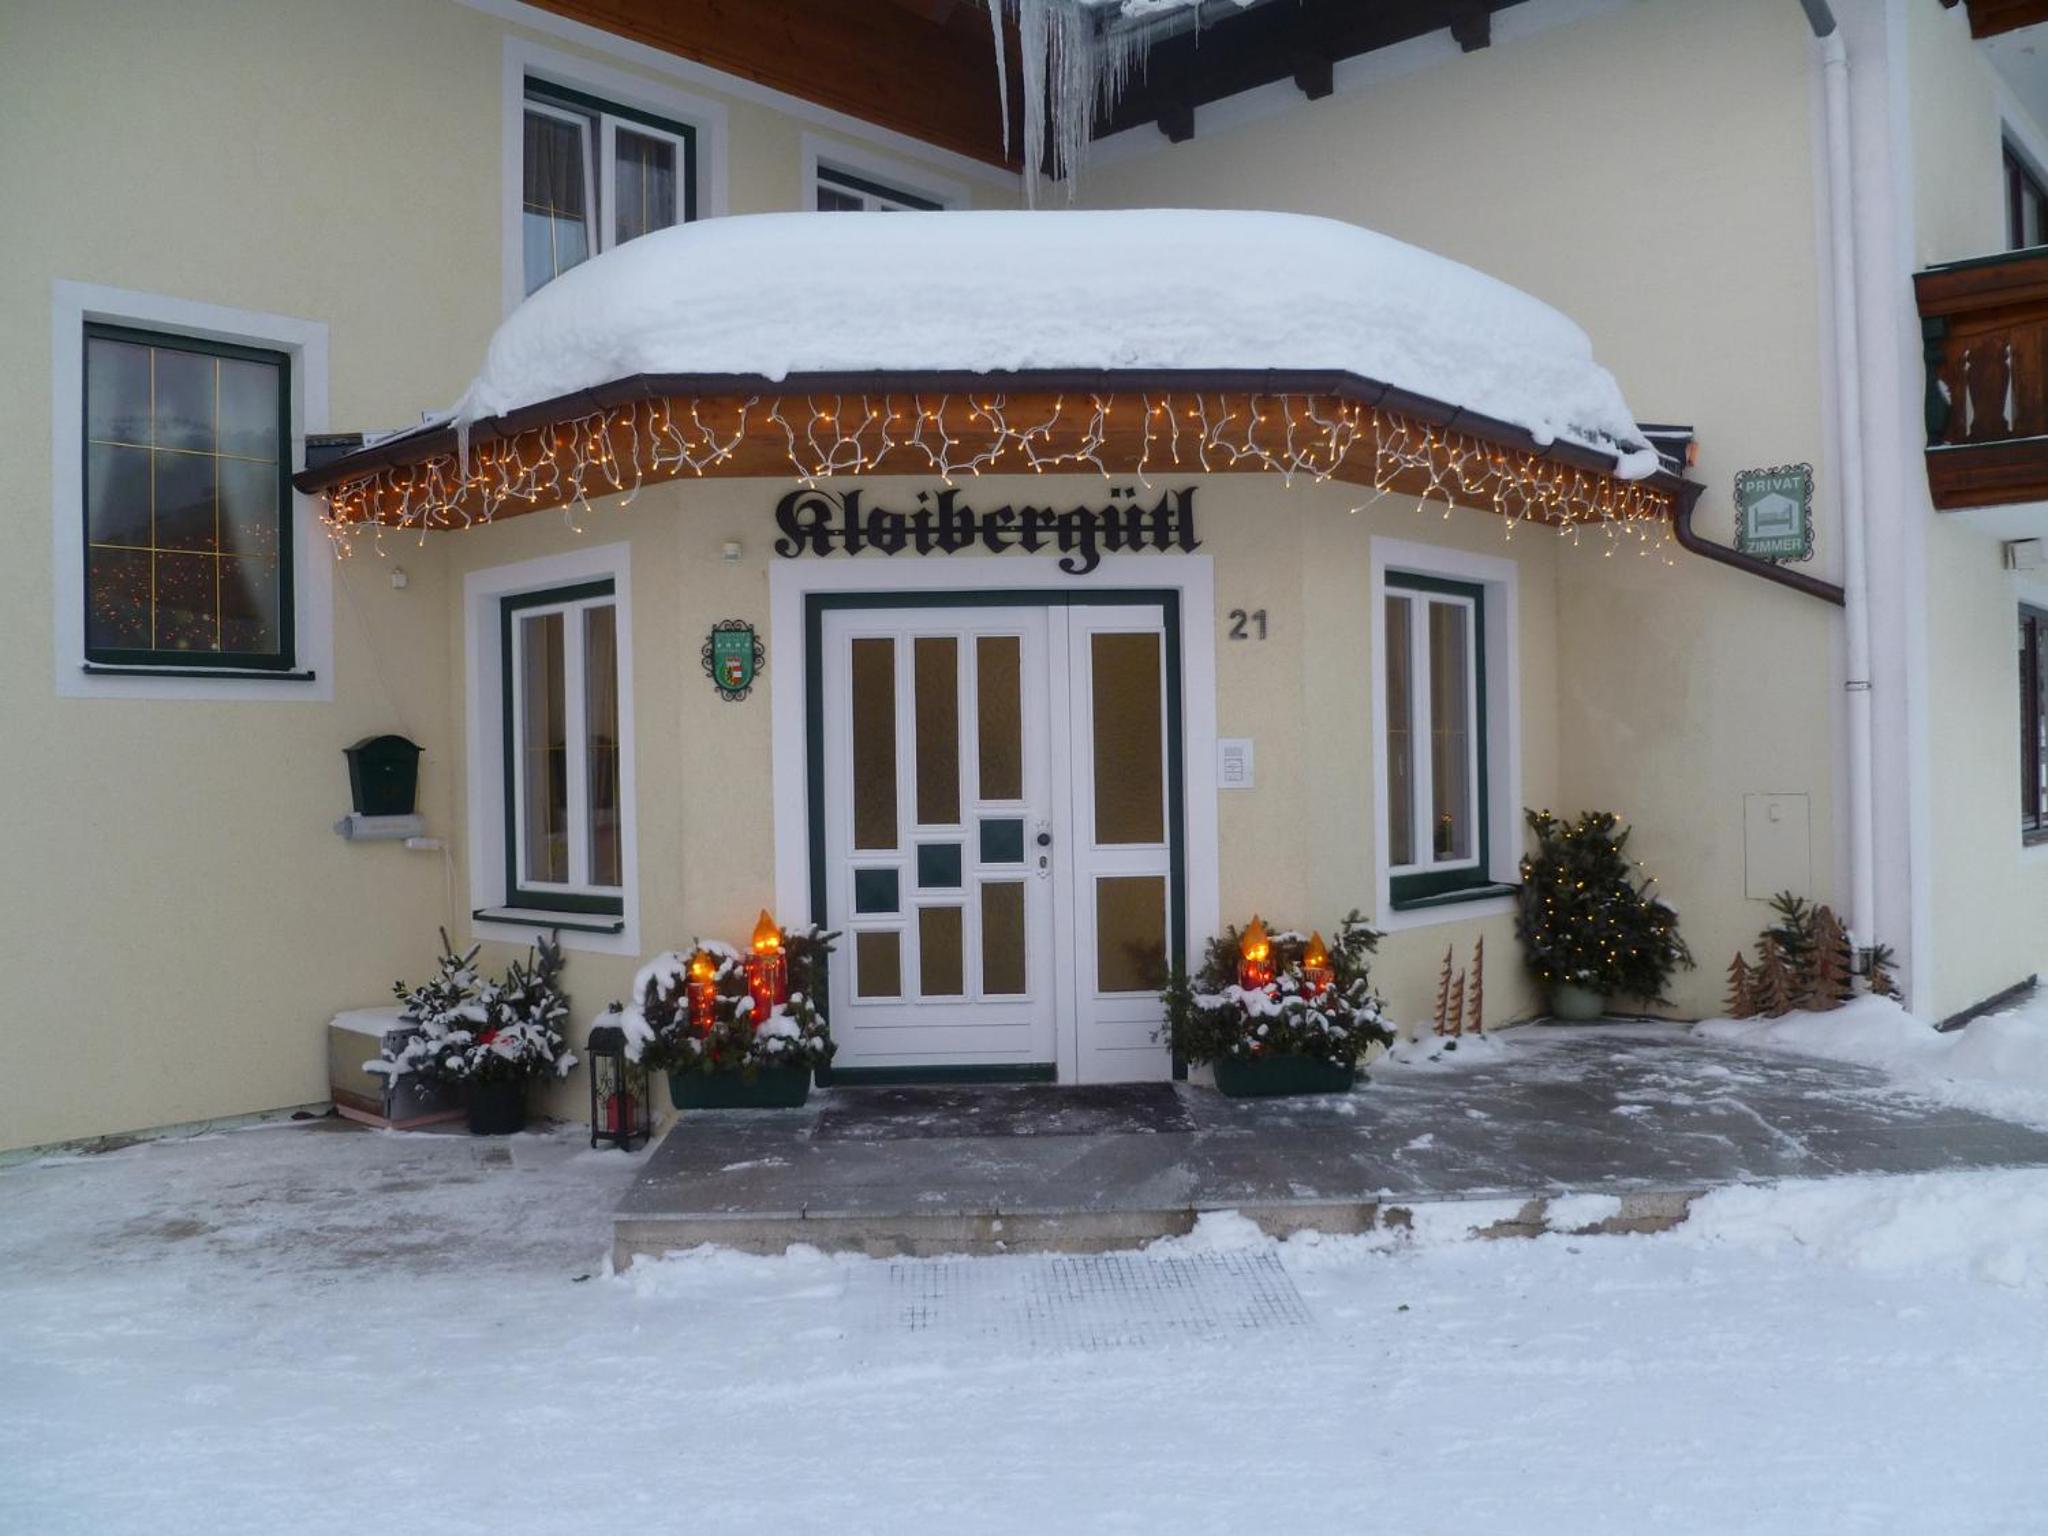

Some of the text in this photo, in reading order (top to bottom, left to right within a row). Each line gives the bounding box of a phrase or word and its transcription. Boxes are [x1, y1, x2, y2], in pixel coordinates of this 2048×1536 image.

[1745, 477, 1801, 492] PRIVAT
[1747, 538, 1803, 554] ZIMMER
[1229, 609, 1267, 640] 21
